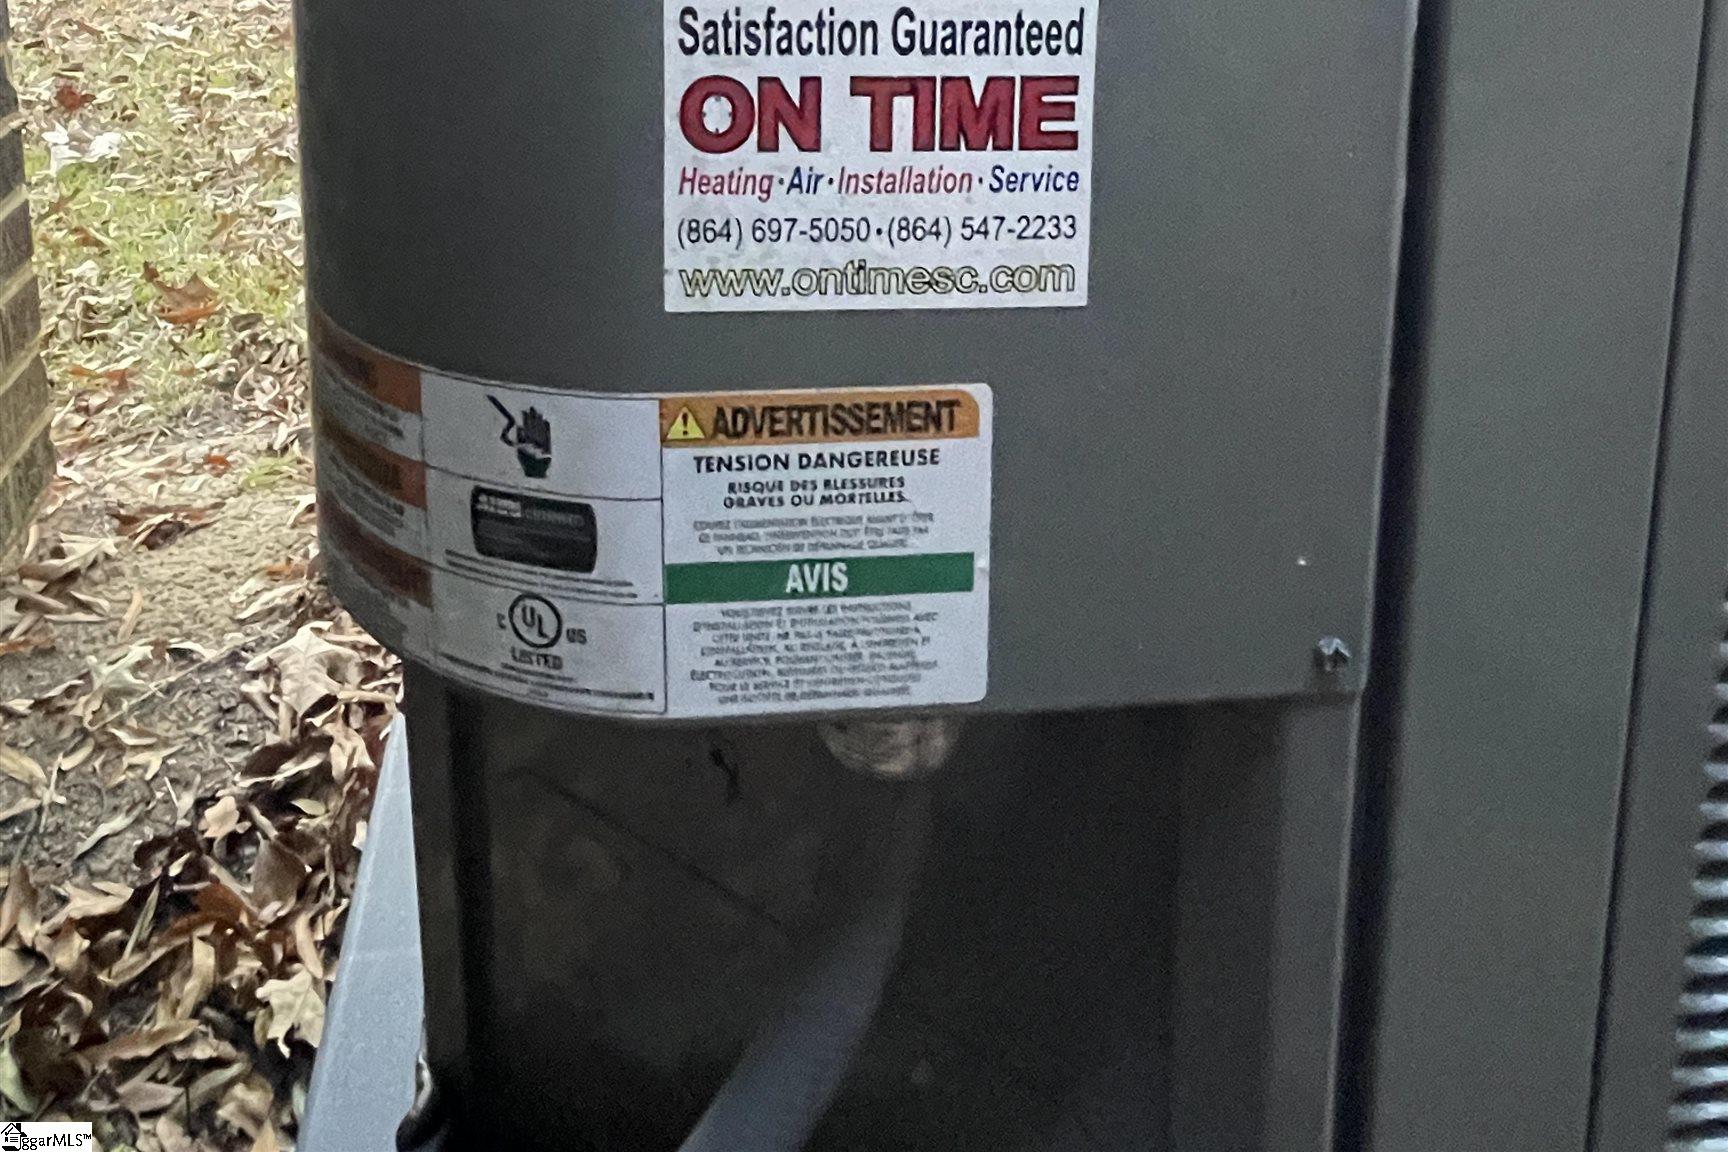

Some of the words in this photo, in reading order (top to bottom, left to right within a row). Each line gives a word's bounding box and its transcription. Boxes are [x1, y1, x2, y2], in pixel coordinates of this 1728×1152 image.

[678, 5, 879, 56] Satisfaction
[891, 7, 1085, 57] Guaranteed
[679, 74, 822, 154] ON
[849, 74, 1080, 153] TIME
[677, 217, 743, 249] (864)
[960, 215, 1077, 241] 547-2233
[678, 259, 1076, 298] www.ontimesc.com
[712, 399, 962, 440] ADVERTISSEMENT
[693, 452, 790, 474] TENSION
[798, 448, 940, 470] DANGEREUSE
[727, 480, 784, 495] RISQUE
[790, 479, 818, 492] DES
[790, 494, 814, 507] OU
[784, 561, 849, 594] AVIS
